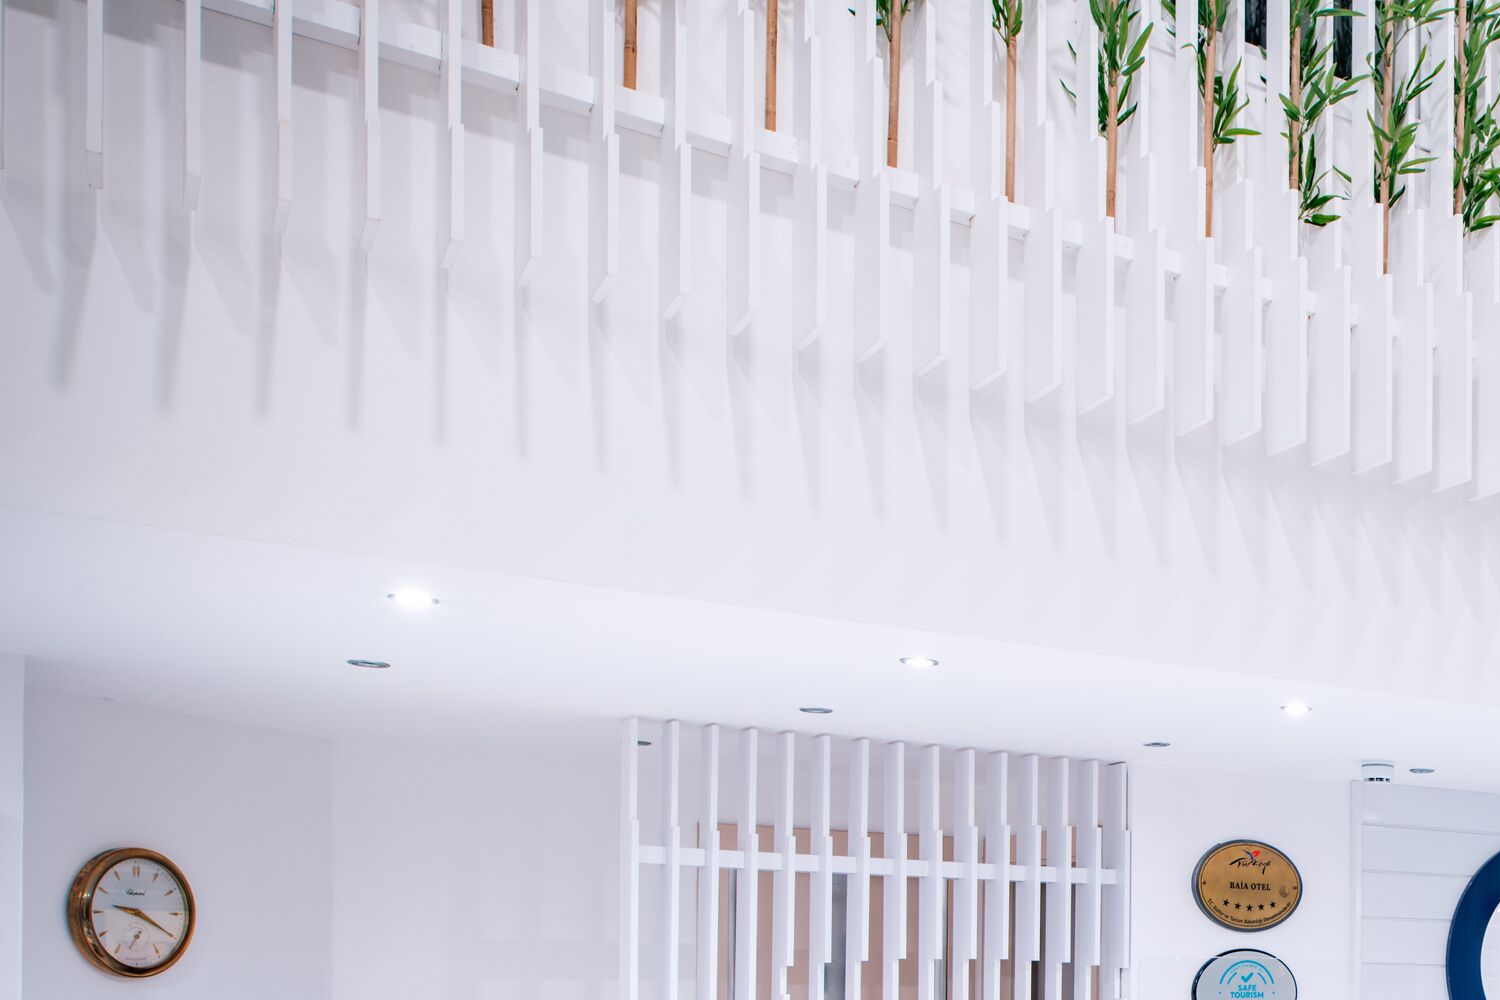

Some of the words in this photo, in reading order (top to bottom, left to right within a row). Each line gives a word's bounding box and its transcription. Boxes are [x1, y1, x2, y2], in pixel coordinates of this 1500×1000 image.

[1229, 857, 1271, 875] Türkiye
[1229, 881, 1248, 890] BAİA
[1250, 882, 1271, 891] OTEL
